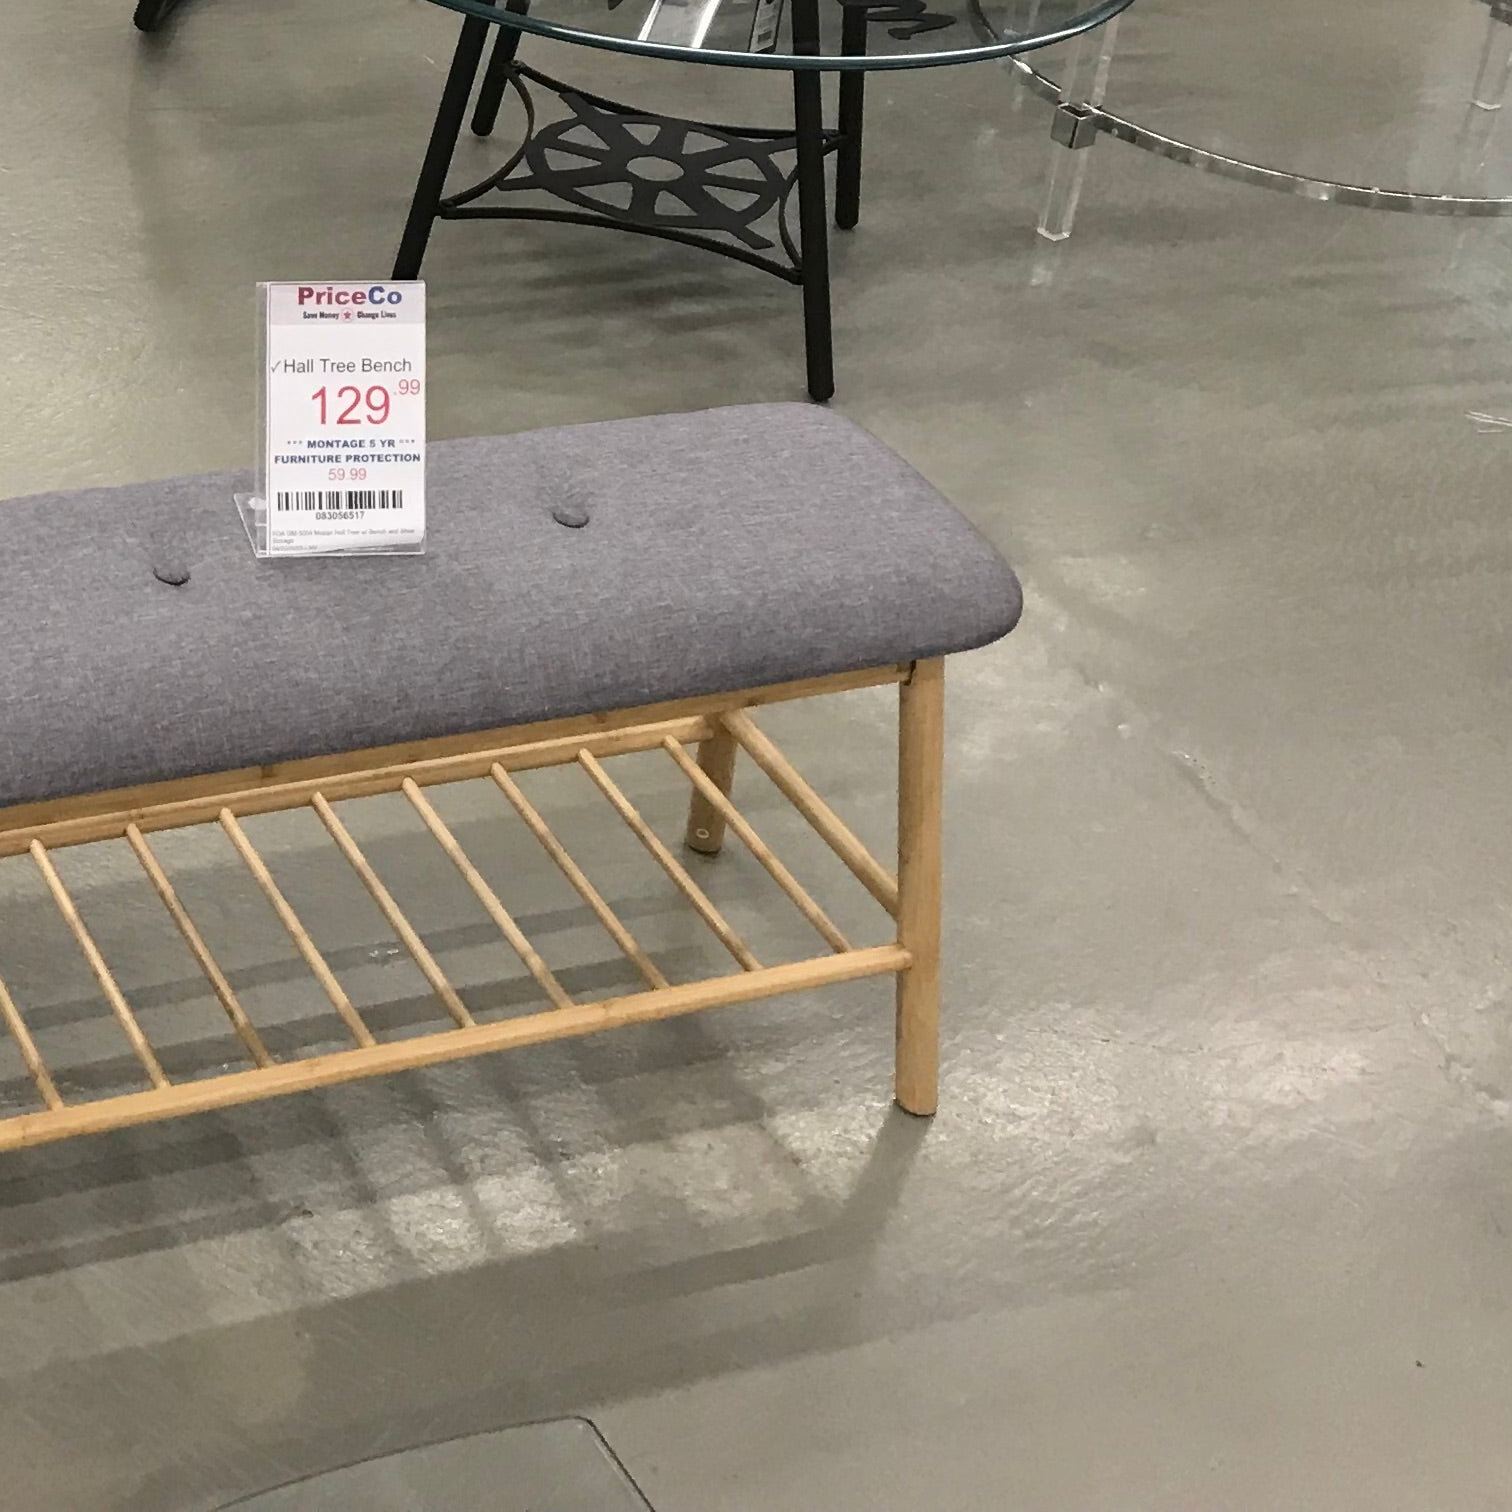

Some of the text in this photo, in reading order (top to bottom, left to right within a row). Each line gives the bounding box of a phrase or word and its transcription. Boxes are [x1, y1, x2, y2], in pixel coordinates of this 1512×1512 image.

[297, 285, 403, 306] PriceCo
[283, 357, 412, 373] Hall Tree Bench
[311, 385, 391, 425] 129
[307, 439, 396, 449] MONTAGE 5 YR
[274, 453, 421, 464] FURNITURE PROTECTION
[328, 467, 367, 481] 59.99
